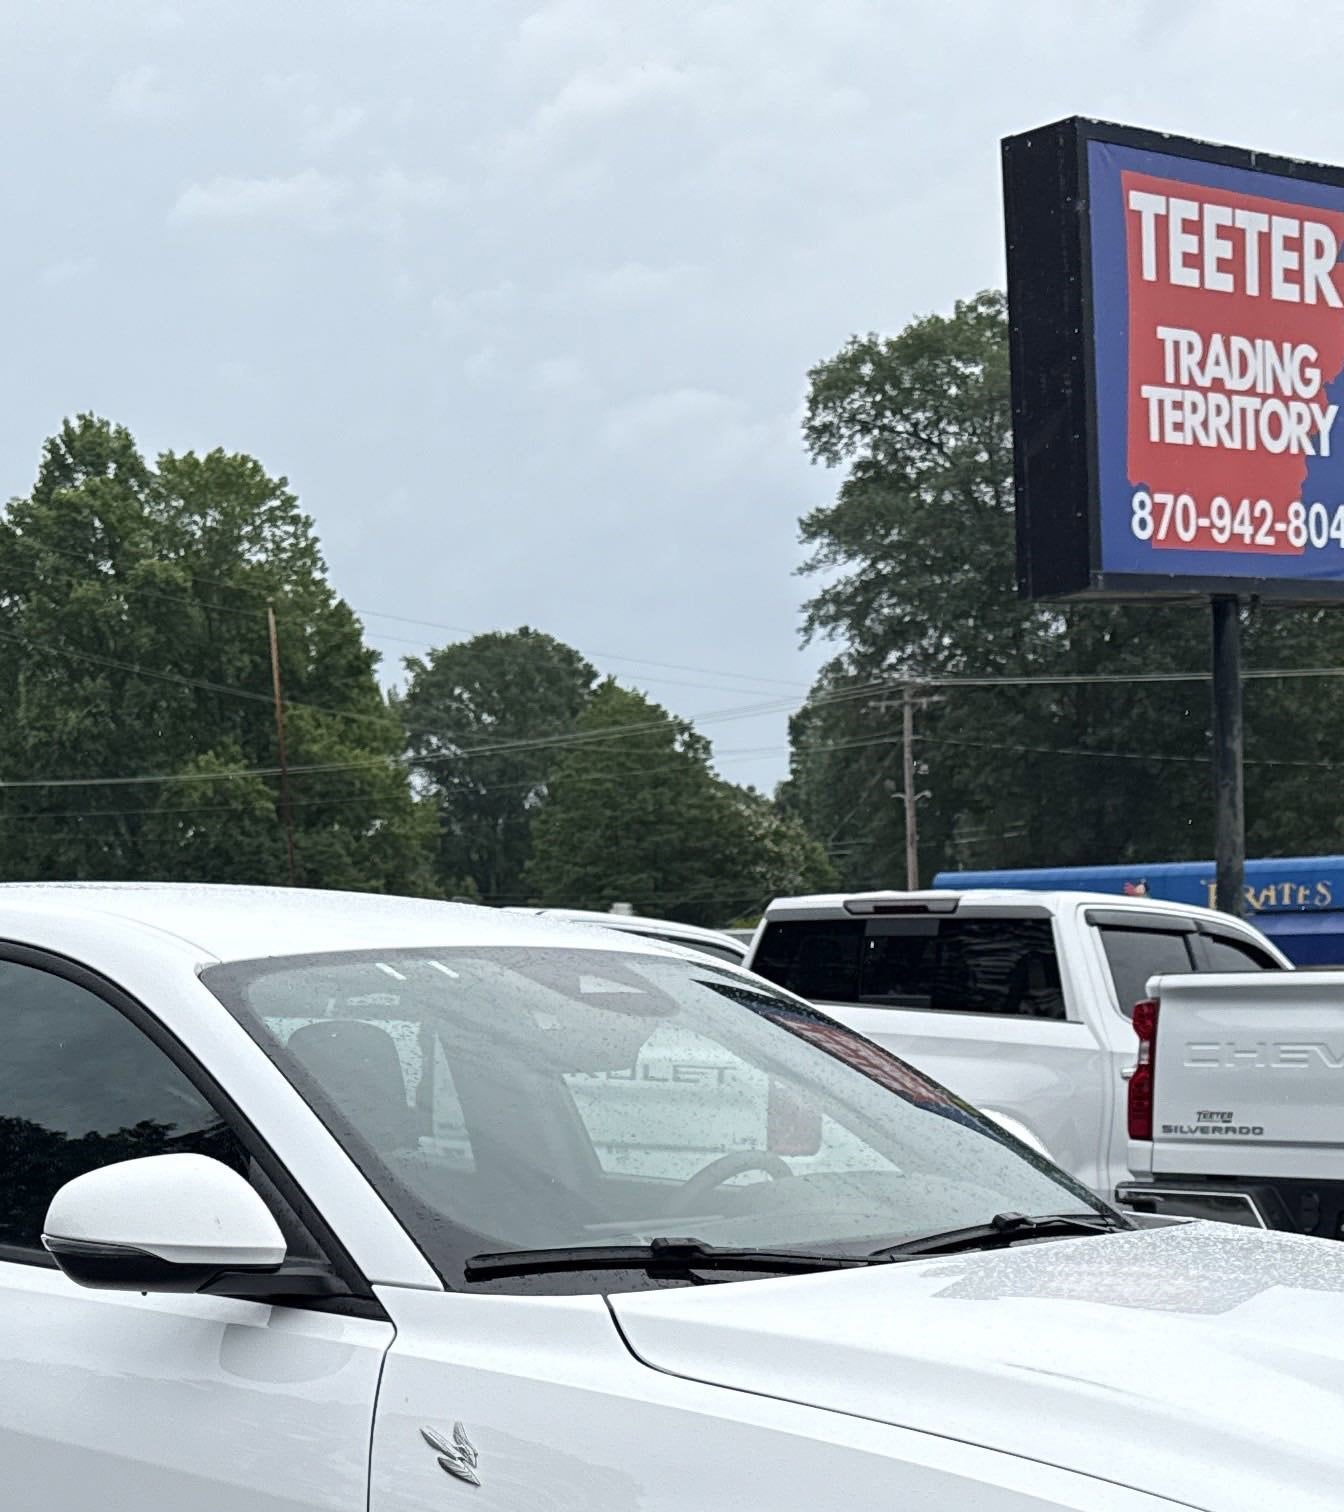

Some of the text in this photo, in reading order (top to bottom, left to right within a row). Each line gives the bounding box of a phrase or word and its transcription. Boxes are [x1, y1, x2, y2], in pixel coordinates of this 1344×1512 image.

[1128, 190, 1344, 308] TEETER
[1156, 326, 1321, 399] TRADING
[1141, 385, 1339, 457] TERRITORY
[1200, 878, 1332, 911] RATES
[1161, 1124, 1264, 1136] SILVERADO
